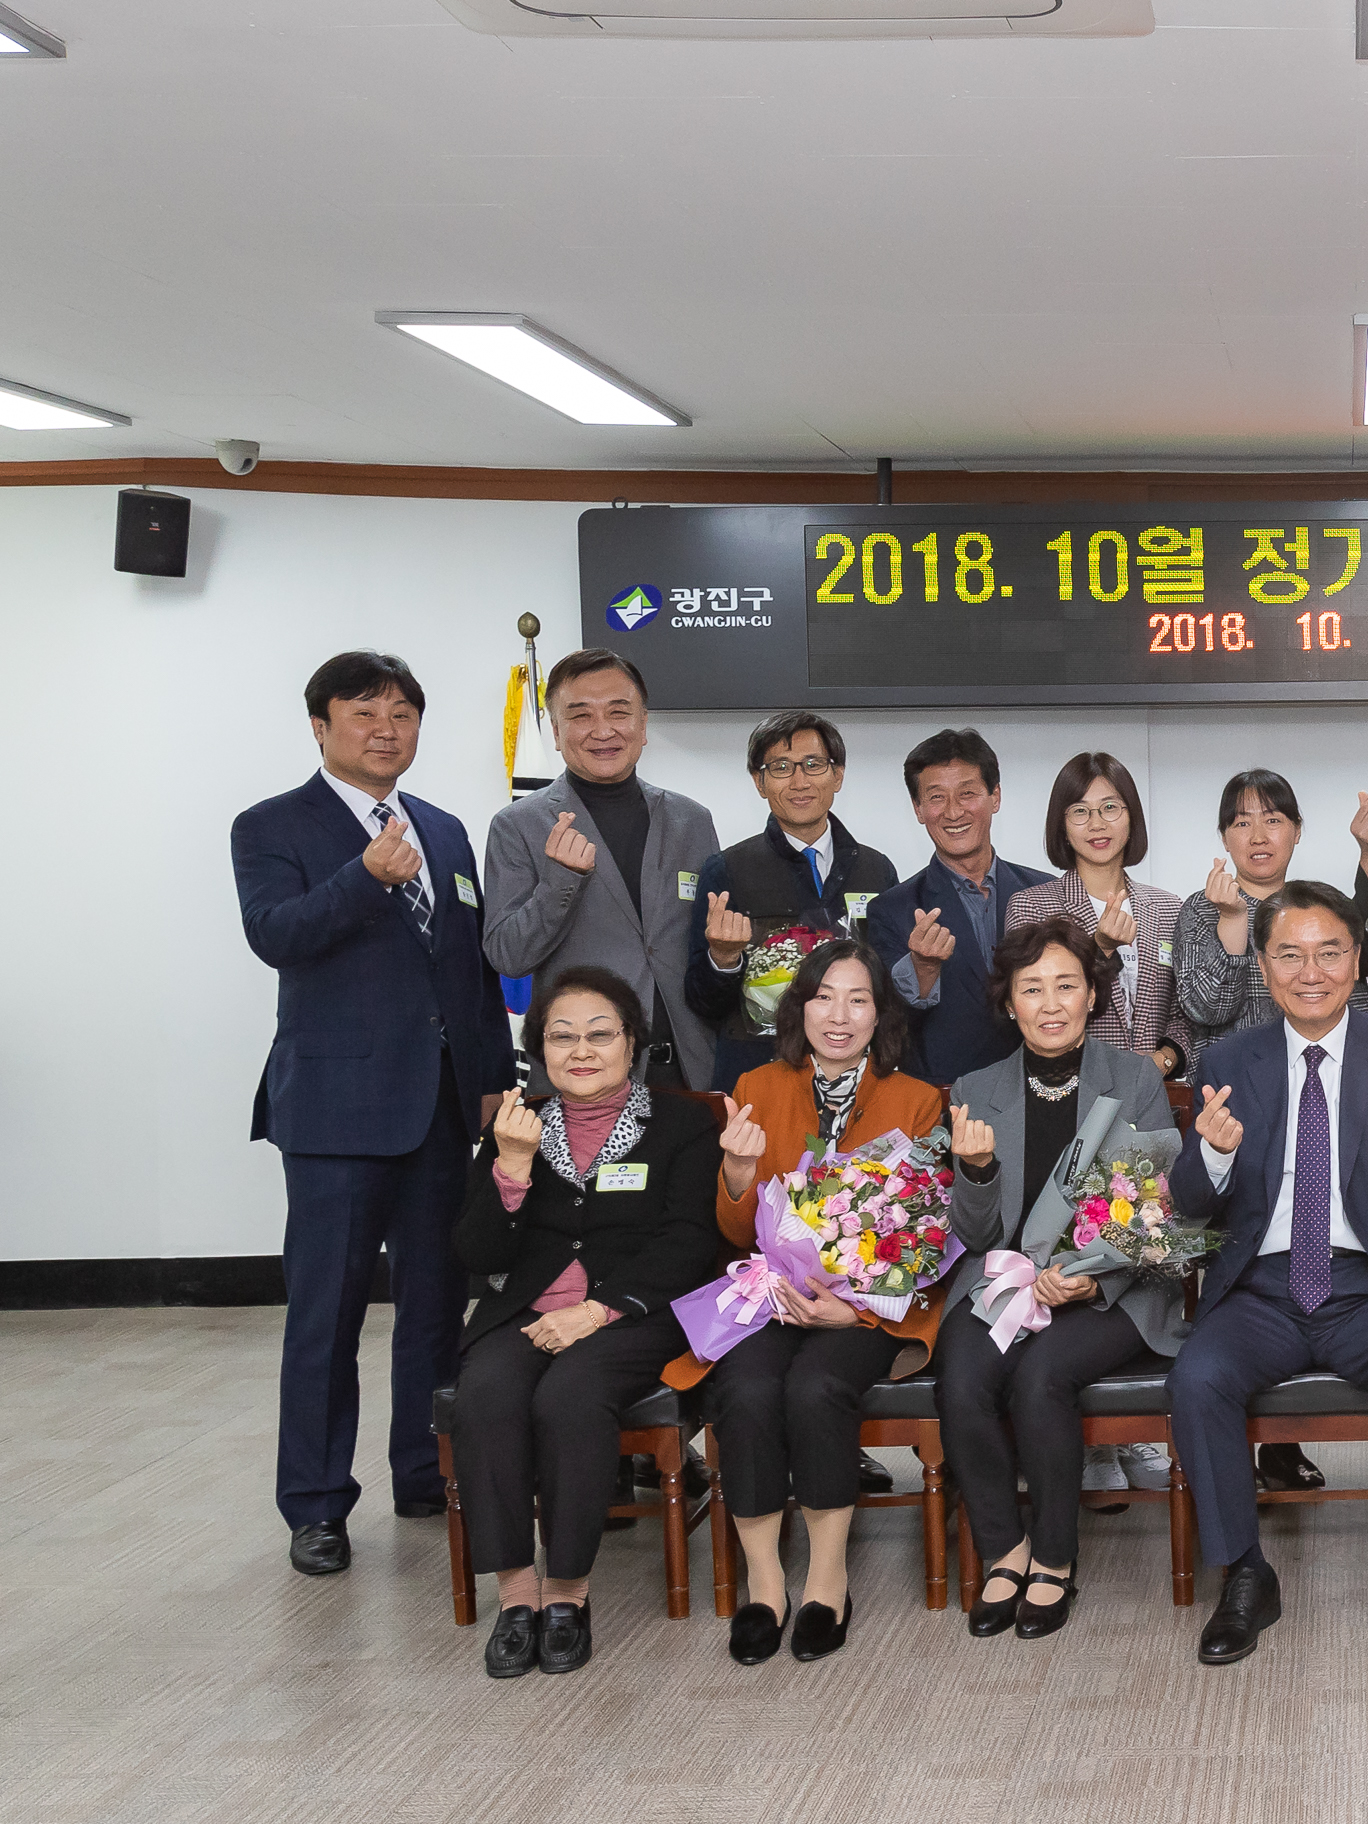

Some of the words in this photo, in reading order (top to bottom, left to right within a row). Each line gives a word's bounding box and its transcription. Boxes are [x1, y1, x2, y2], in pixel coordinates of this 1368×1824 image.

[816, 532, 1014, 604] 2018.
[1046, 526, 1205, 604] 10월
[669, 587, 774, 613] 광진구
[671, 616, 772, 628] GWANGJIN-GU
[1148, 611, 1255, 653] 2018.
[1296, 611, 1352, 651] 10.
